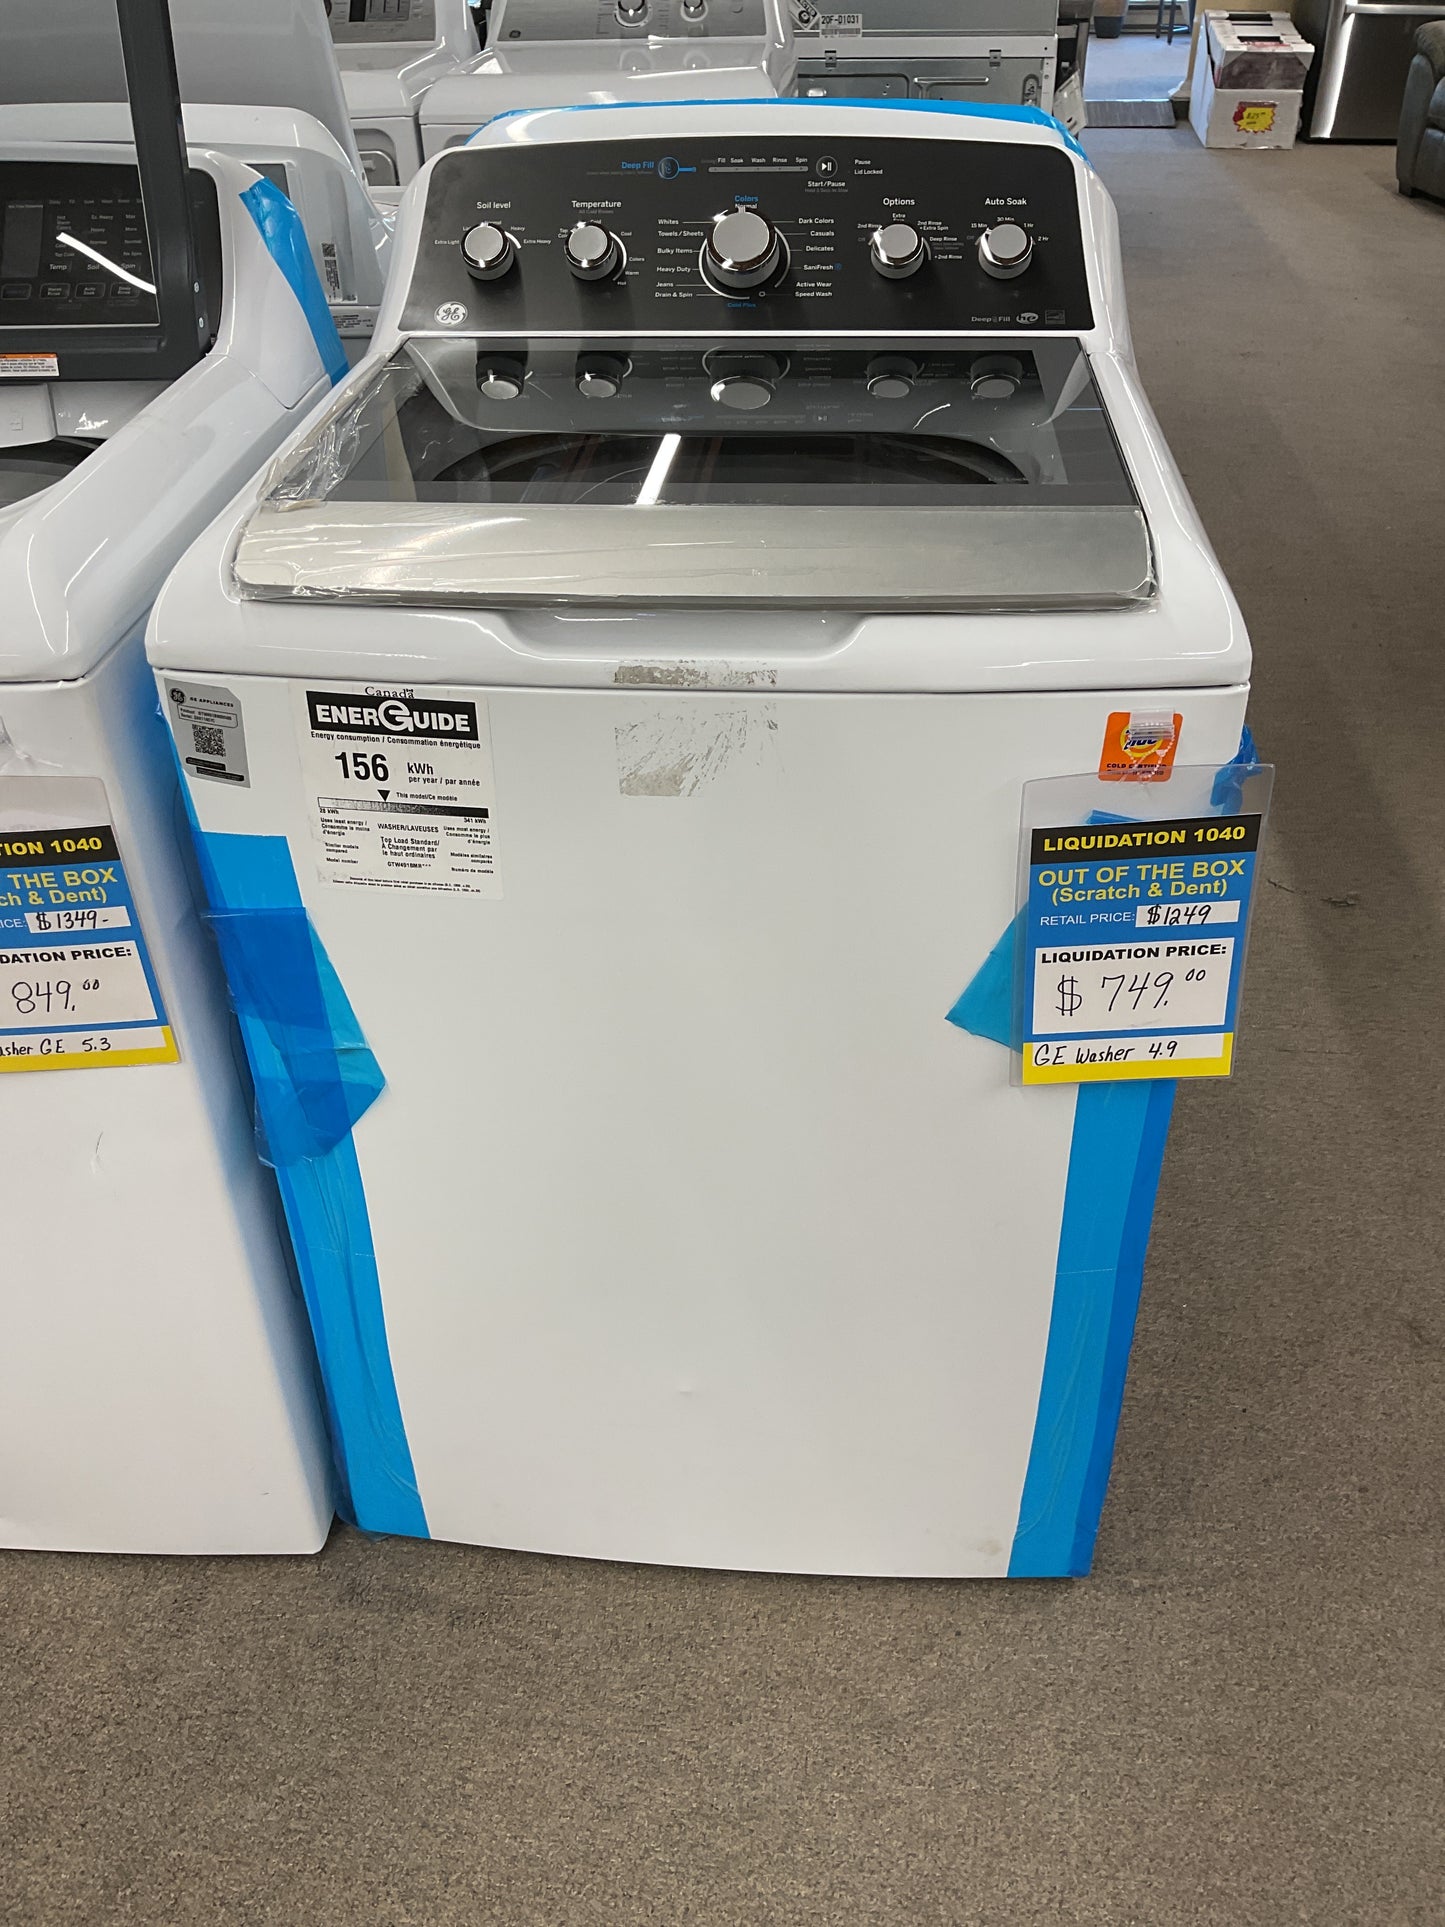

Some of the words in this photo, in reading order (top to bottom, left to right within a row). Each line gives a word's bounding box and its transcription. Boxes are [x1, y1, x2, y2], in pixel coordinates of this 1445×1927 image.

[621, 161, 641, 170] Deep
[642, 161, 655, 169] Fill
[795, 156, 809, 164] Spin
[854, 158, 871, 166] Pause
[807, 180, 846, 188] Start/Pause
[734, 195, 759, 203] Colors
[882, 197, 916, 207] Options
[984, 197, 1005, 206] Auto
[1006, 197, 1027, 206] Soak
[476, 201, 492, 209] Soil
[493, 201, 512, 209] level
[571, 200, 622, 210] Temperature
[49, 263, 68, 271] Temp
[87, 263, 100, 271] Soil
[120, 262, 136, 270] Spin
[364, 686, 415, 699] Canada
[311, 731, 335, 741] Energy
[336, 734, 381, 744] consumption
[387, 736, 438, 747] Consommation
[439, 739, 481, 749] énergétique
[334, 751, 389, 782] 156
[407, 762, 434, 775] kWh
[408, 776, 420, 784] per
[423, 776, 438, 785] year
[445, 778, 457, 786] par
[458, 778, 481, 787] année
[396, 791, 408, 799] This
[377, 823, 439, 834] WASHER/LAVEUSES
[50, 836, 103, 853] 1040
[380, 836, 392, 844] Top
[393, 837, 409, 845] Load
[410, 838, 440, 847] Standard/
[1043, 830, 1186, 852] LIQUIDATION
[1193, 826, 1246, 842] 1040
[387, 843, 426, 852] Changement
[405, 851, 436, 860] ordinaires
[1038, 868, 1090, 887] OUT
[1096, 866, 1130, 884] OF
[1137, 862, 1185, 881] THE
[1192, 858, 1246, 878] BOX
[7, 872, 58, 890] THE
[63, 867, 118, 887] BOX
[28, 890, 45, 905] &
[48, 886, 107, 904] Dent)
[1052, 884, 1140, 906] (Scratch
[1147, 882, 1163, 897] &
[1170, 878, 1227, 897] Dent)
[1040, 914, 1086, 926] RETAIL
[1090, 911, 1135, 923] PRICE:
[1146, 904, 1212, 926] $1249
[71, 946, 132, 961] PRICE:
[1041, 947, 1159, 964] LIQUIDATION
[1165, 943, 1227, 957] PRICE:
[1055, 974, 1083, 1016] $
[40, 1038, 65, 1055] GE
[82, 1037, 111, 1052] 5.3
[1034, 1043, 1068, 1066] GE
[1075, 1045, 1136, 1065] Washer
[1148, 1040, 1178, 1060] 4.9
